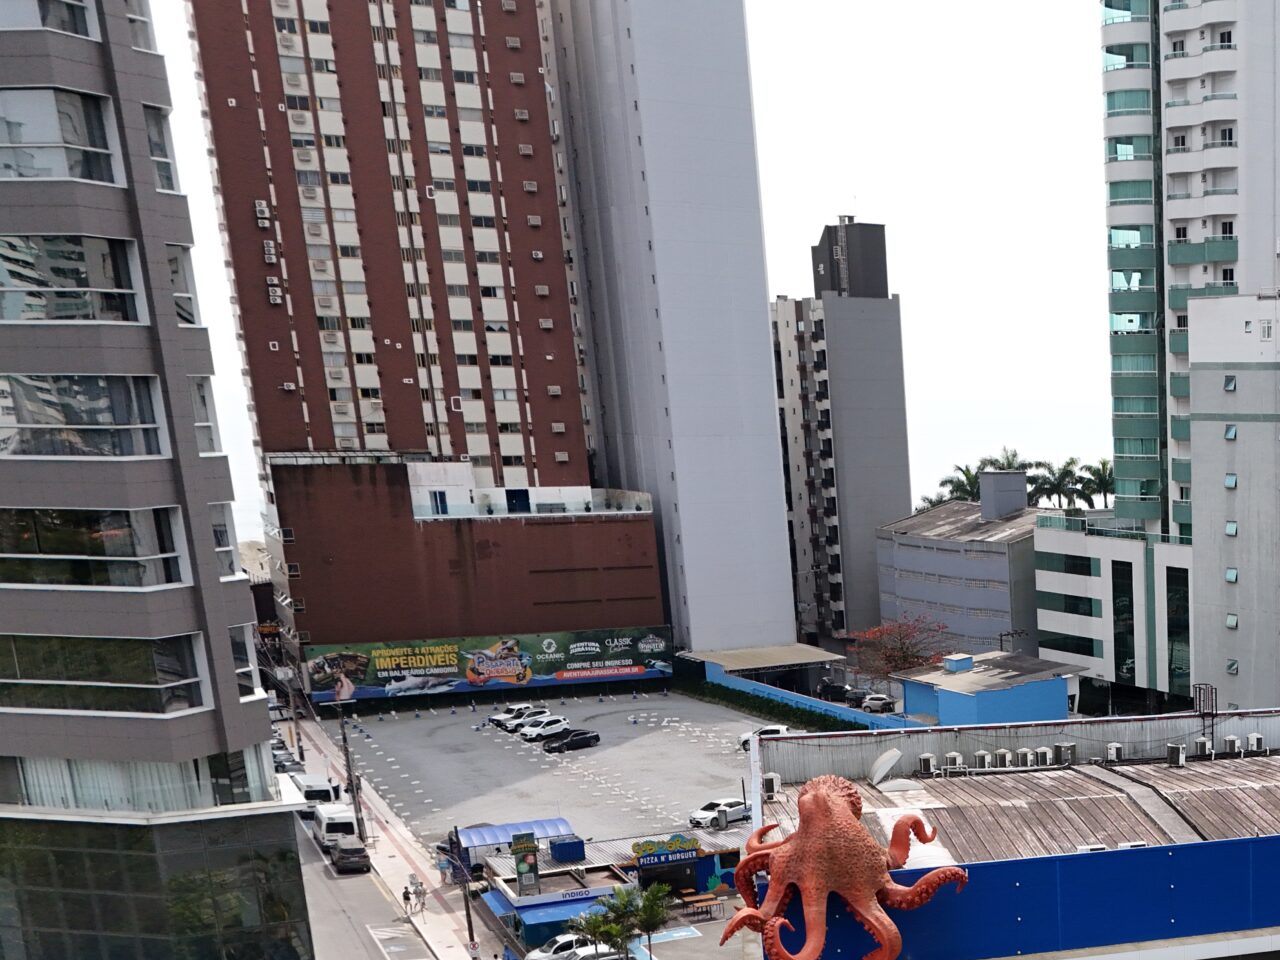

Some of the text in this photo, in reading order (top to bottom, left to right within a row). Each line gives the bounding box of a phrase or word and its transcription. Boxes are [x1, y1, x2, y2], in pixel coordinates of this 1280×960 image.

[372, 648, 413, 657] APROVEITE
[421, 644, 459, 654] ATRAÇÕES
[569, 641, 600, 649] AVENTURA
[376, 653, 458, 669] IMPERDÍVEIS
[566, 662, 591, 670] COMPRE
[605, 659, 633, 667] INGRESSO
[389, 668, 425, 677] BALNEÁRIO
[426, 666, 458, 675] CAMBORIÚ
[668, 850, 697, 860] BURGUER
[562, 890, 590, 898] INDIGO
